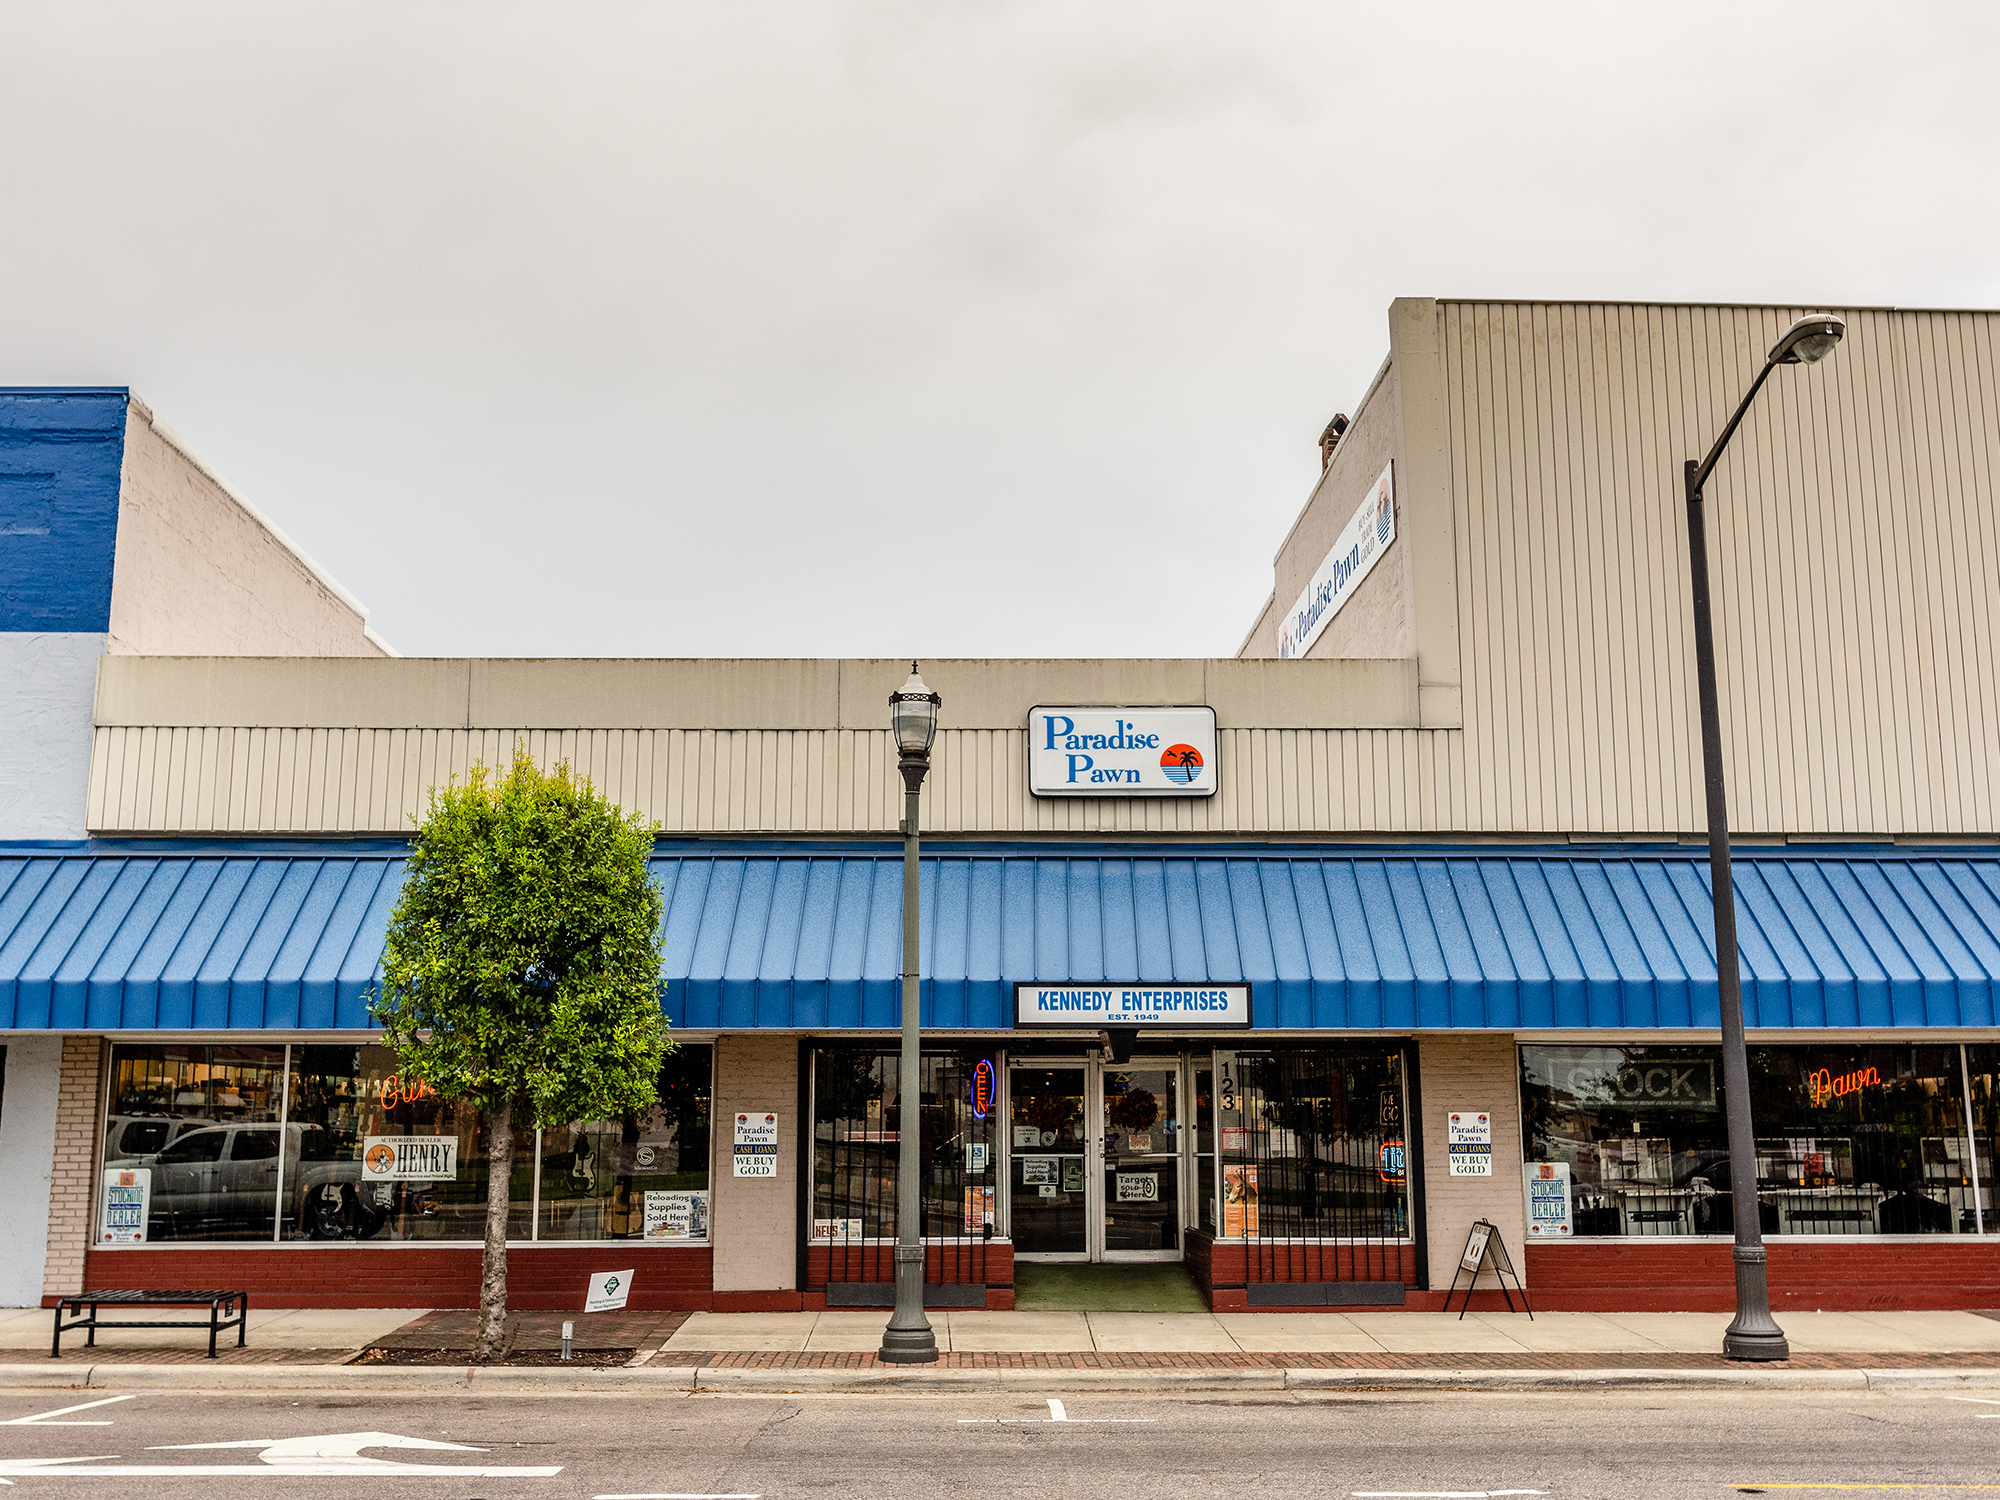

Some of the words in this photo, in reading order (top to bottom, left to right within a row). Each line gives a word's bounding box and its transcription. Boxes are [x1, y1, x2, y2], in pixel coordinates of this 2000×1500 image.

[1360, 537, 1375, 564] GOLD
[1298, 579, 1332, 643] Paradise
[1333, 543, 1360, 597] Pawn
[1043, 716, 1160, 750] Paradise
[1065, 754, 1142, 784] Pawn
[1038, 991, 1112, 1011] KENNEDY
[1121, 991, 1229, 1011] ENTERPRISES
[976, 1062, 989, 1113] OPEN
[1810, 1066, 1881, 1106] Pawn
[737, 1126, 775, 1134] Paradise
[1451, 1126, 1488, 1134] Paradise
[1458, 1134, 1482, 1142] Pawn
[754, 1146, 776, 1154] LOANS
[1450, 1145, 1468, 1153] CASH
[1469, 1145, 1491, 1153] LOANS
[396, 1144, 452, 1173] HENRY
[735, 1156, 751, 1165] WE
[753, 1157, 775, 1165] BUY
[1451, 1156, 1467, 1164] WE
[1469, 1156, 1489, 1164] BUY
[740, 1166, 770, 1175] GOLD
[1456, 1165, 1486, 1174] GOLD
[1119, 1176, 1154, 1184] Targets
[1531, 1182, 1565, 1196] STOCKING
[108, 1189, 143, 1203] STOCKING
[648, 1203, 687, 1212] Supplies
[1532, 1203, 1566, 1217] DEALER
[106, 1211, 142, 1224] DEALER
